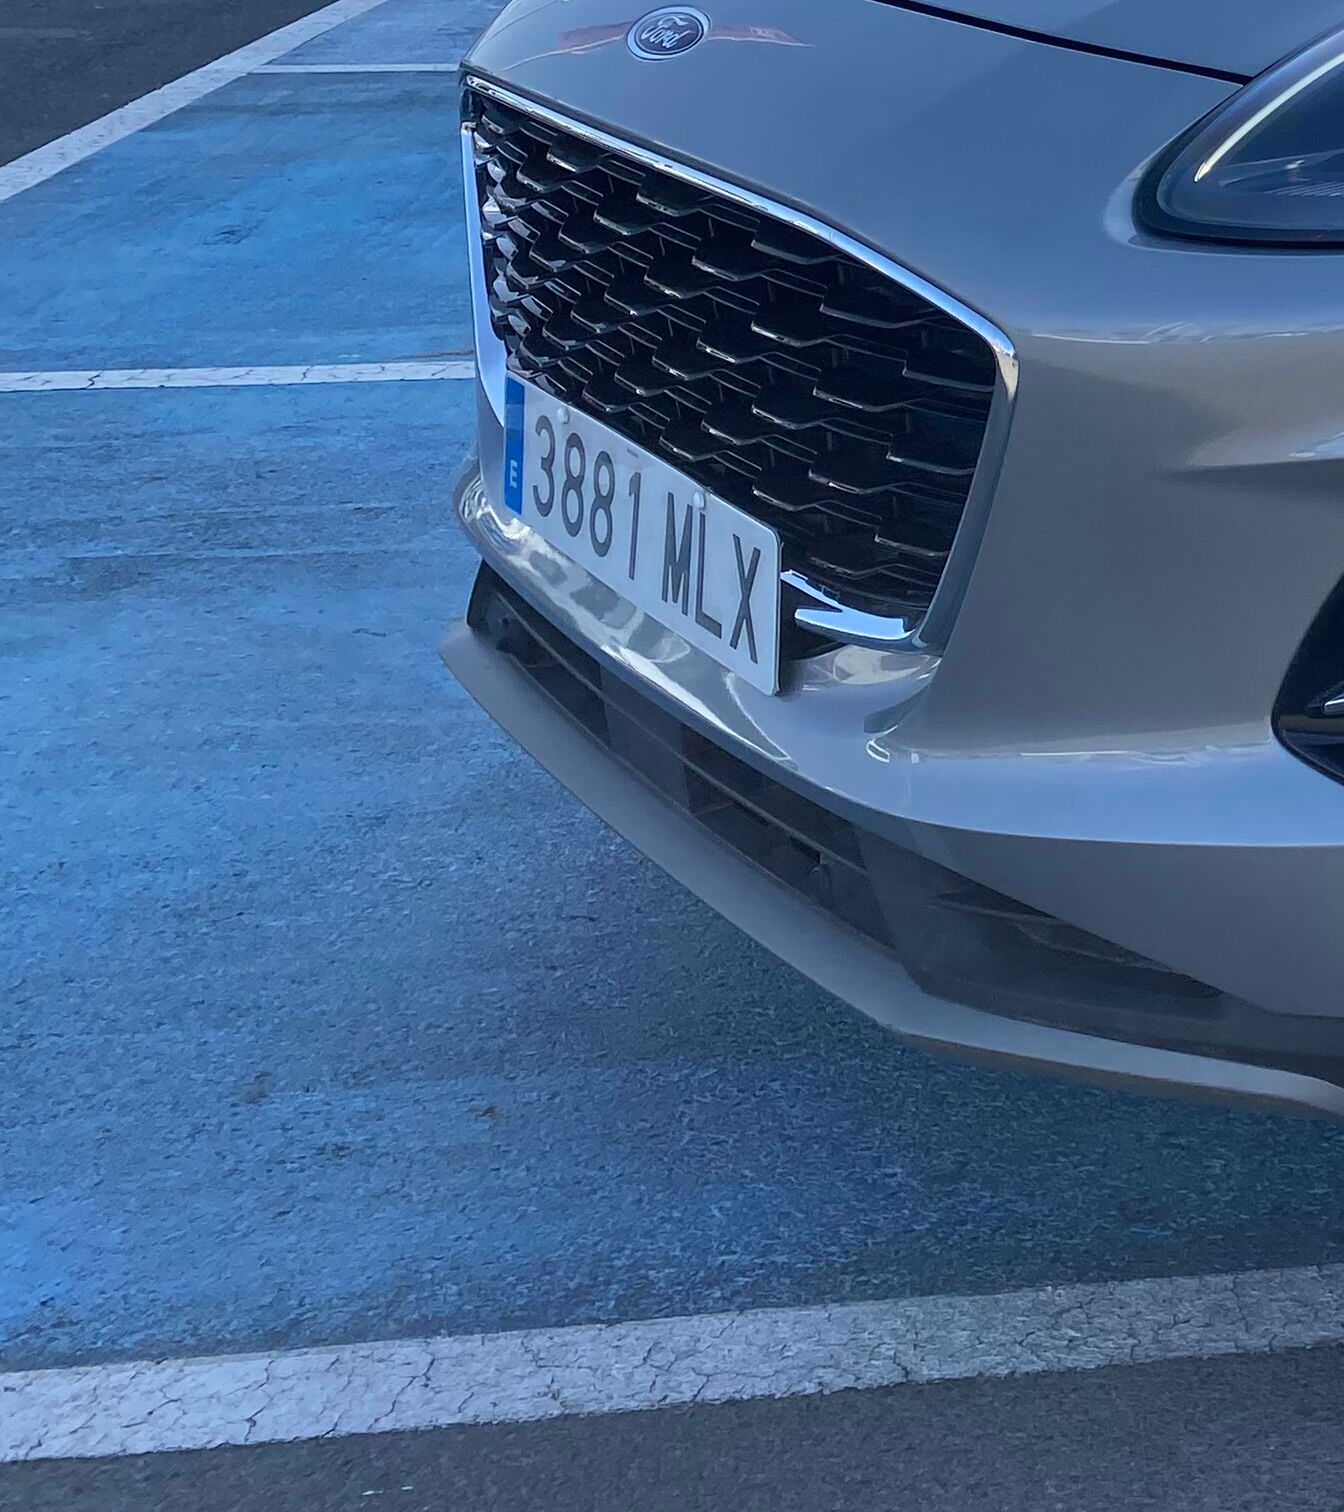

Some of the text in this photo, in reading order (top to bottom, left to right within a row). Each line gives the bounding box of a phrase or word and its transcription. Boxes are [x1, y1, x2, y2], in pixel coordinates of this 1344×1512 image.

[641, 15, 692, 48] Ford
[509, 459, 518, 490] E
[532, 415, 762, 665] 3881 MLX
